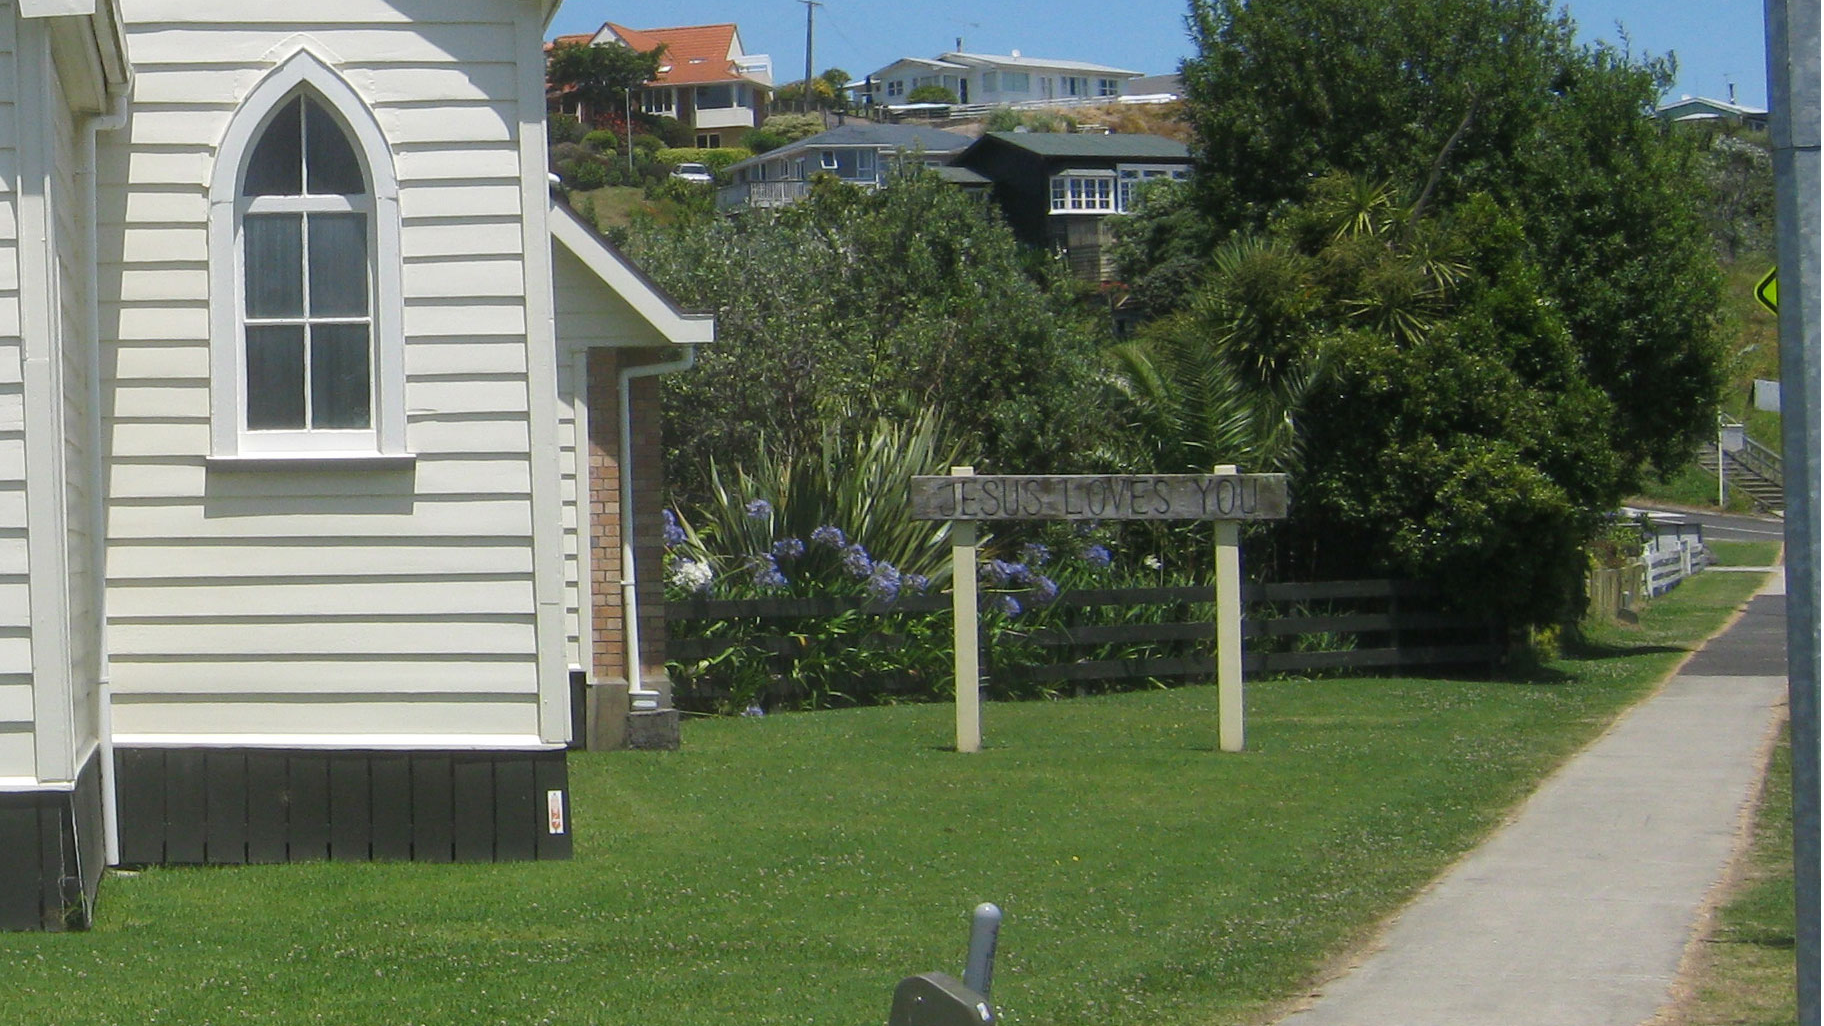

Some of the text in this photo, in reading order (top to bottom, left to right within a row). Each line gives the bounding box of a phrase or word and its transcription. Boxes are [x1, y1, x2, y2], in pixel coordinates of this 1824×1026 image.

[937, 477, 1259, 517] JESUS LOVES YOU
